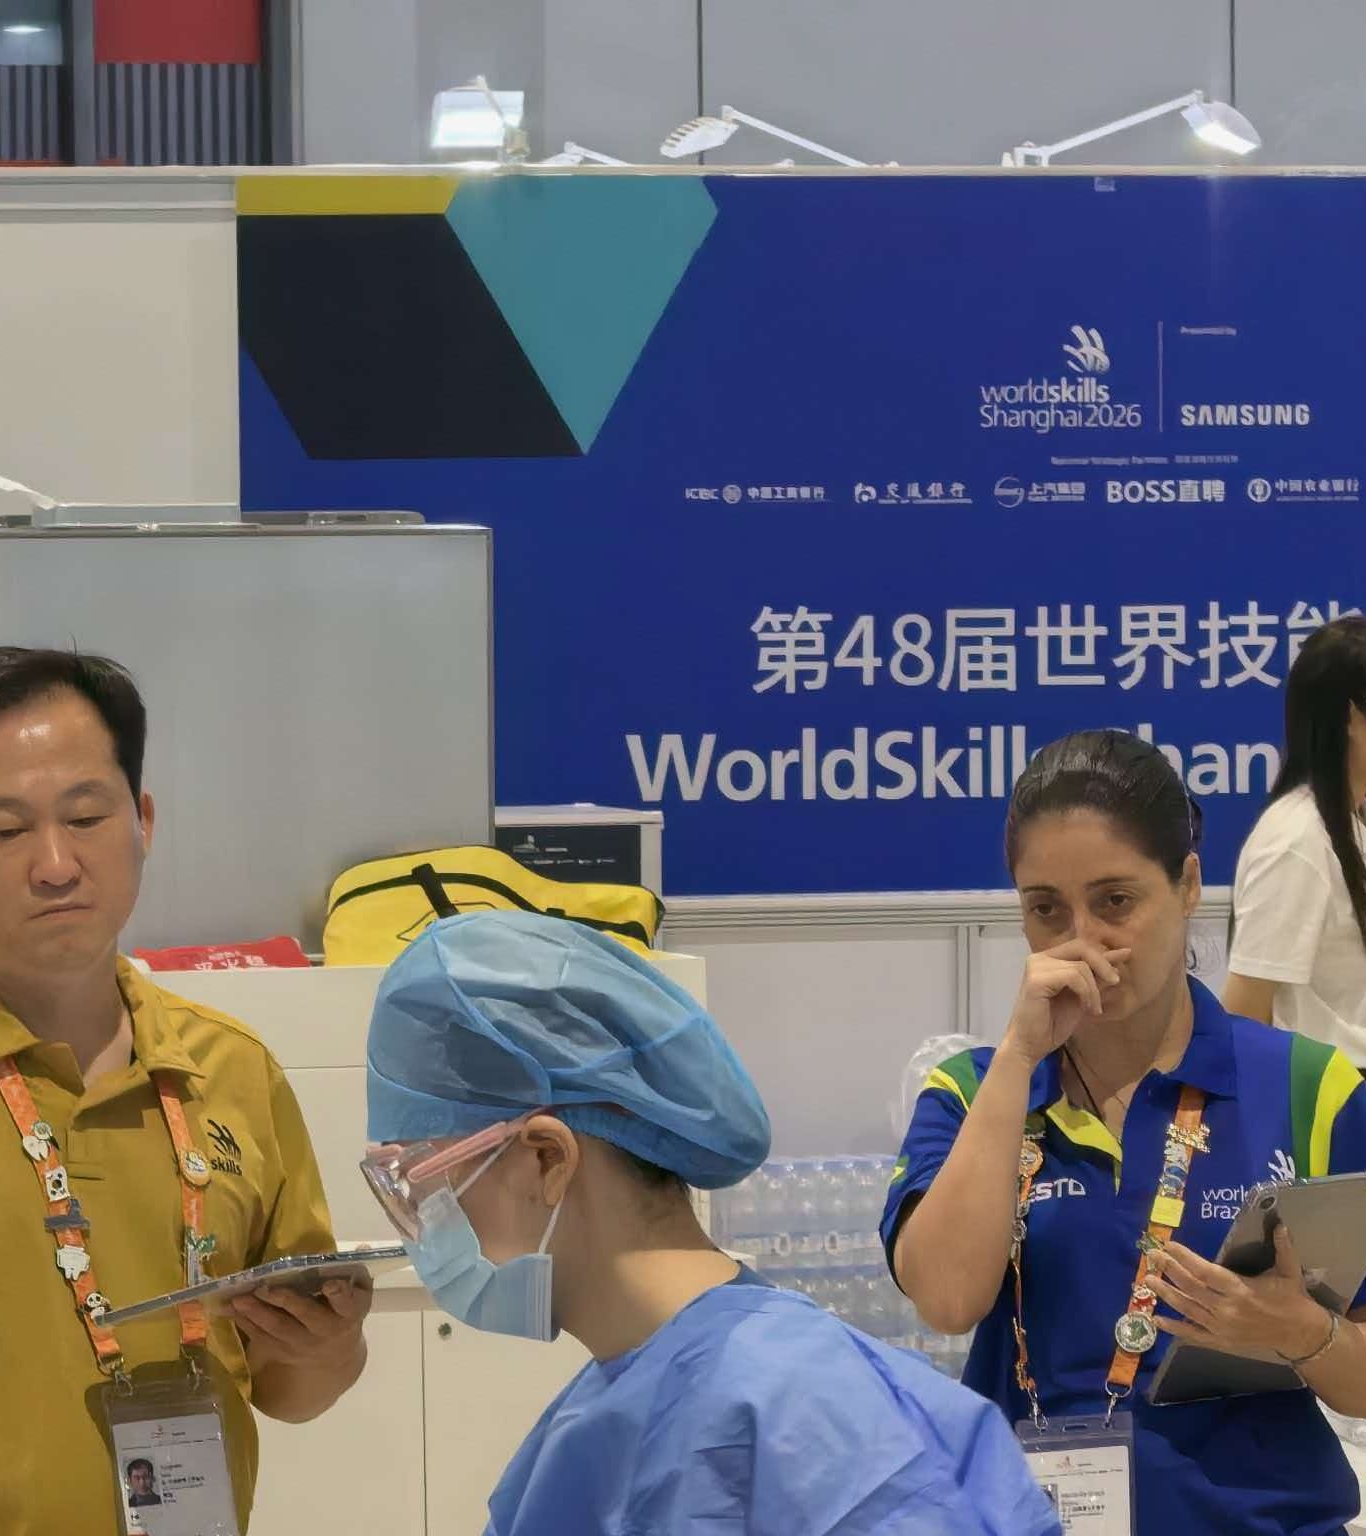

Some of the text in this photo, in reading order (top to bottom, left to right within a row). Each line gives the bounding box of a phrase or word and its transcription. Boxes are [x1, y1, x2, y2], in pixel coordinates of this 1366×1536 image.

[980, 378, 1110, 404] worldskills
[1181, 404, 1310, 426] SAMSUNG
[625, 725, 1044, 802] WorldSkill
[1201, 1202, 1241, 1220] Braz
